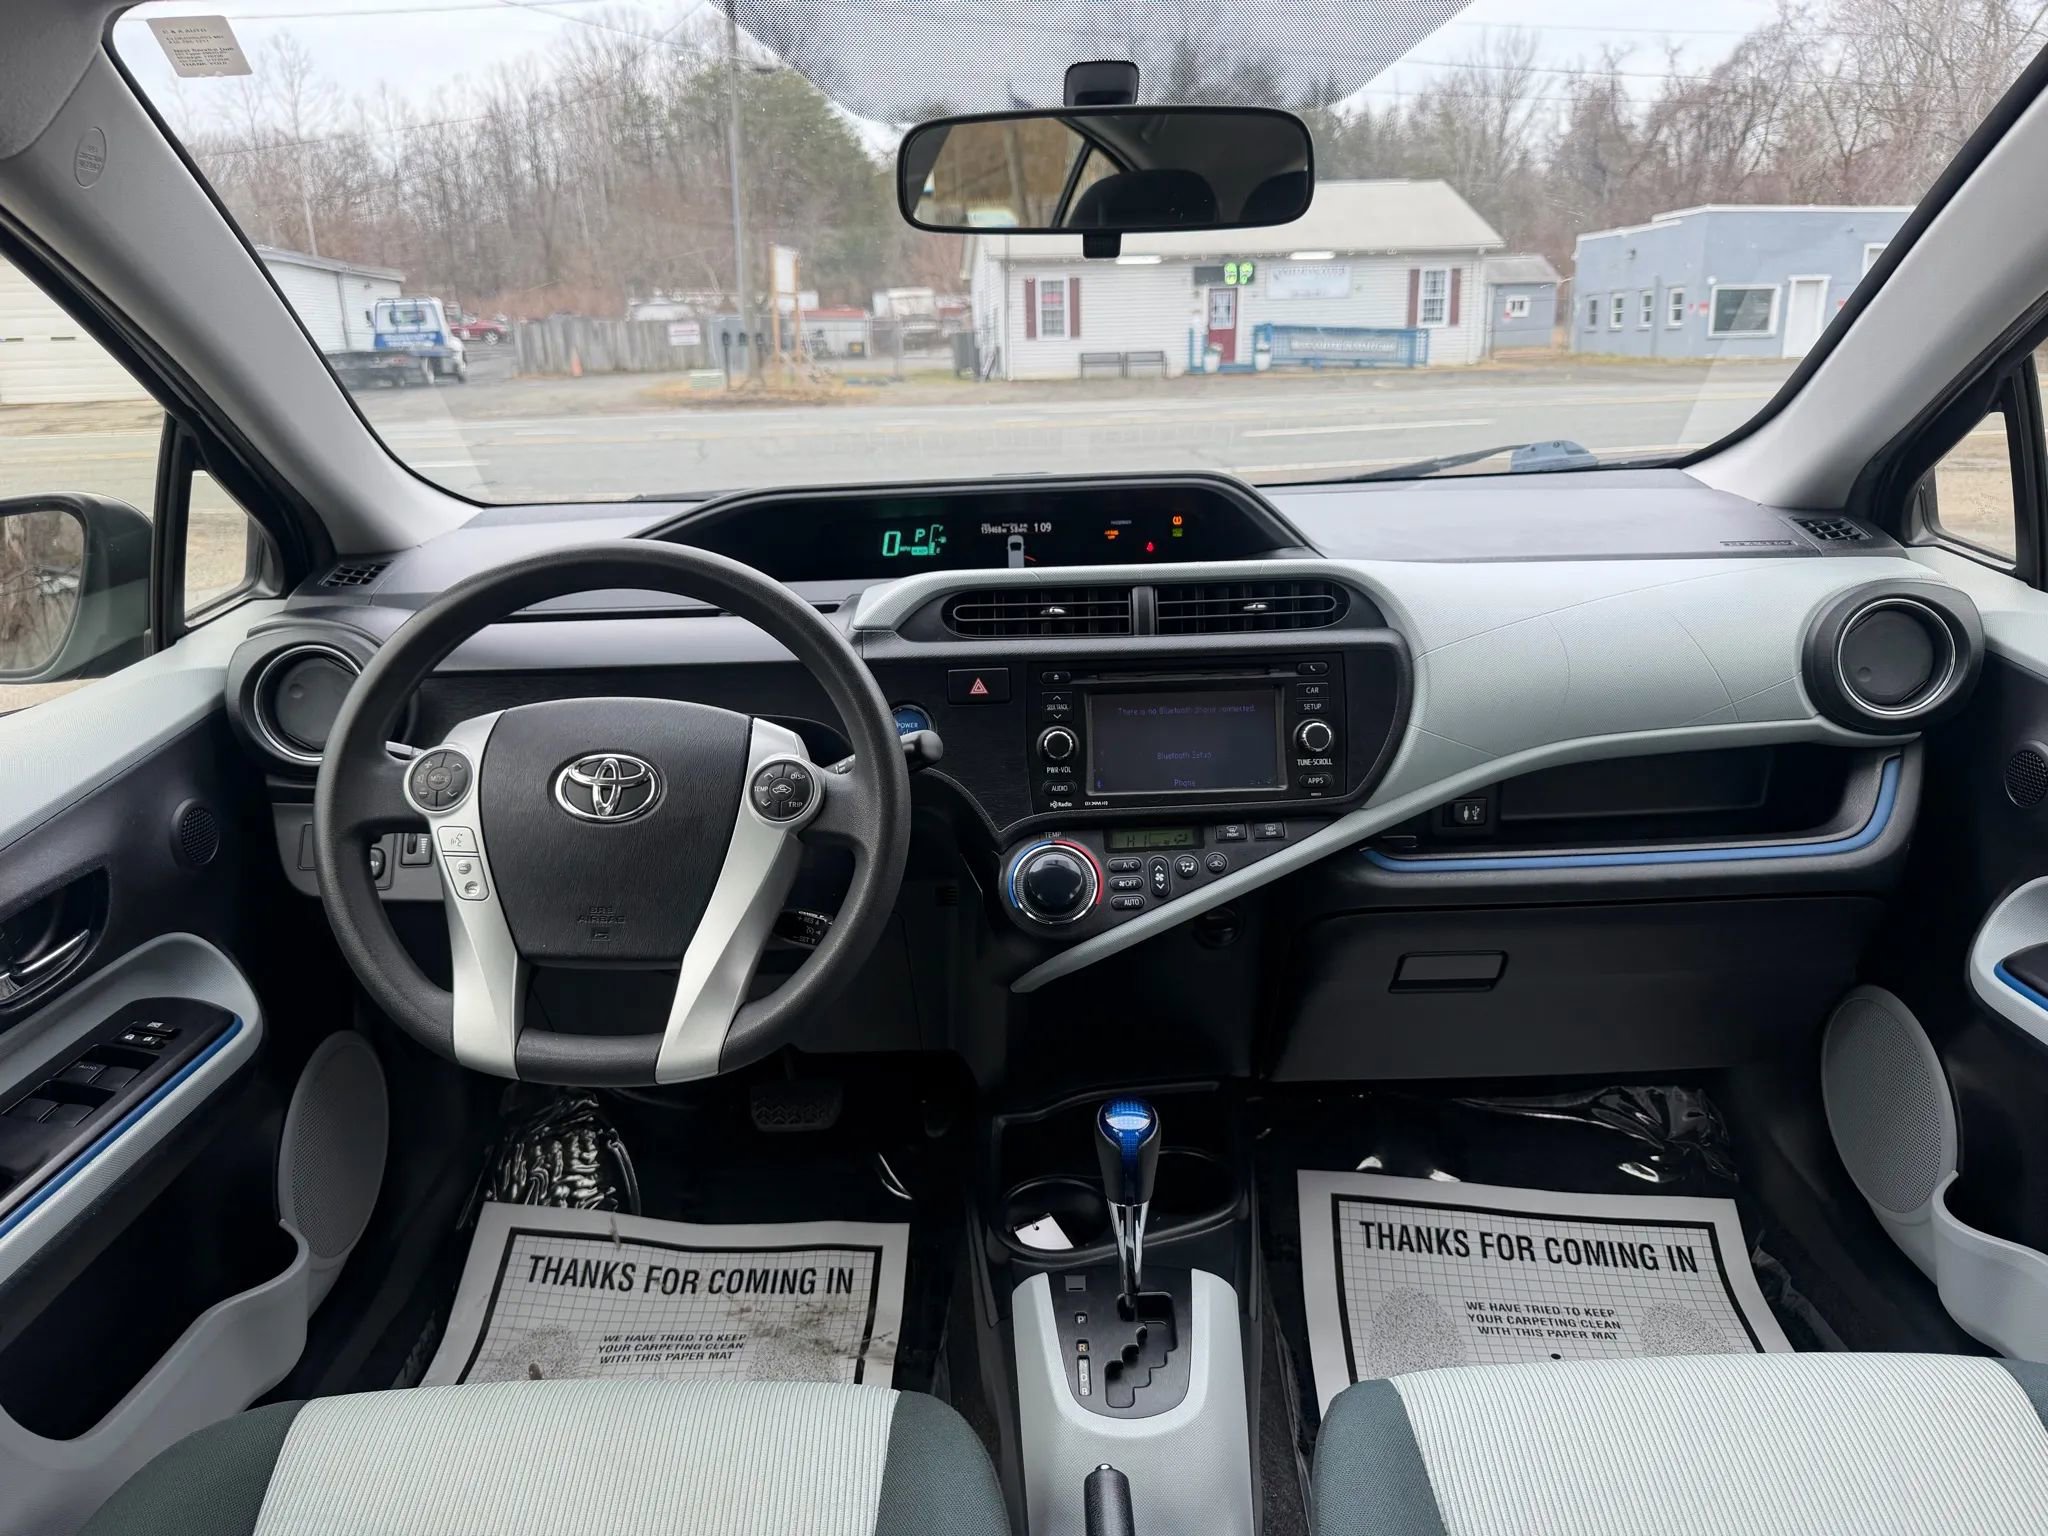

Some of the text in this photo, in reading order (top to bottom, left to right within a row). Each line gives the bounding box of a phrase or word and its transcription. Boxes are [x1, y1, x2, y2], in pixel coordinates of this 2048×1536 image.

[914, 528, 926, 543] P
[896, 721, 919, 729] POWER
[754, 785, 769, 793] TEMP
[1122, 861, 1135, 869] A/C
[1125, 879, 1137, 887] OFF
[1123, 898, 1140, 906] AUTO
[1359, 1219, 1699, 1274] THANKS FOR COMING IN
[527, 1253, 855, 1296] THANKS FOR COMING IN
[1466, 1301, 1615, 1318] WE HAVE TRIED TO KEEP
[1077, 1315, 1085, 1324] P
[1466, 1313, 1622, 1330] YOUR CARPETING CLEAN
[603, 1333, 747, 1342] WE HAVE TRIED TO KEEP
[1477, 1326, 1618, 1341] WITH THIS PAPER MAT
[598, 1341, 745, 1353] YOUR CARPETING CLEAN
[1078, 1343, 1086, 1352] R
[600, 1351, 735, 1364] WITH THIS PAPER MAT
